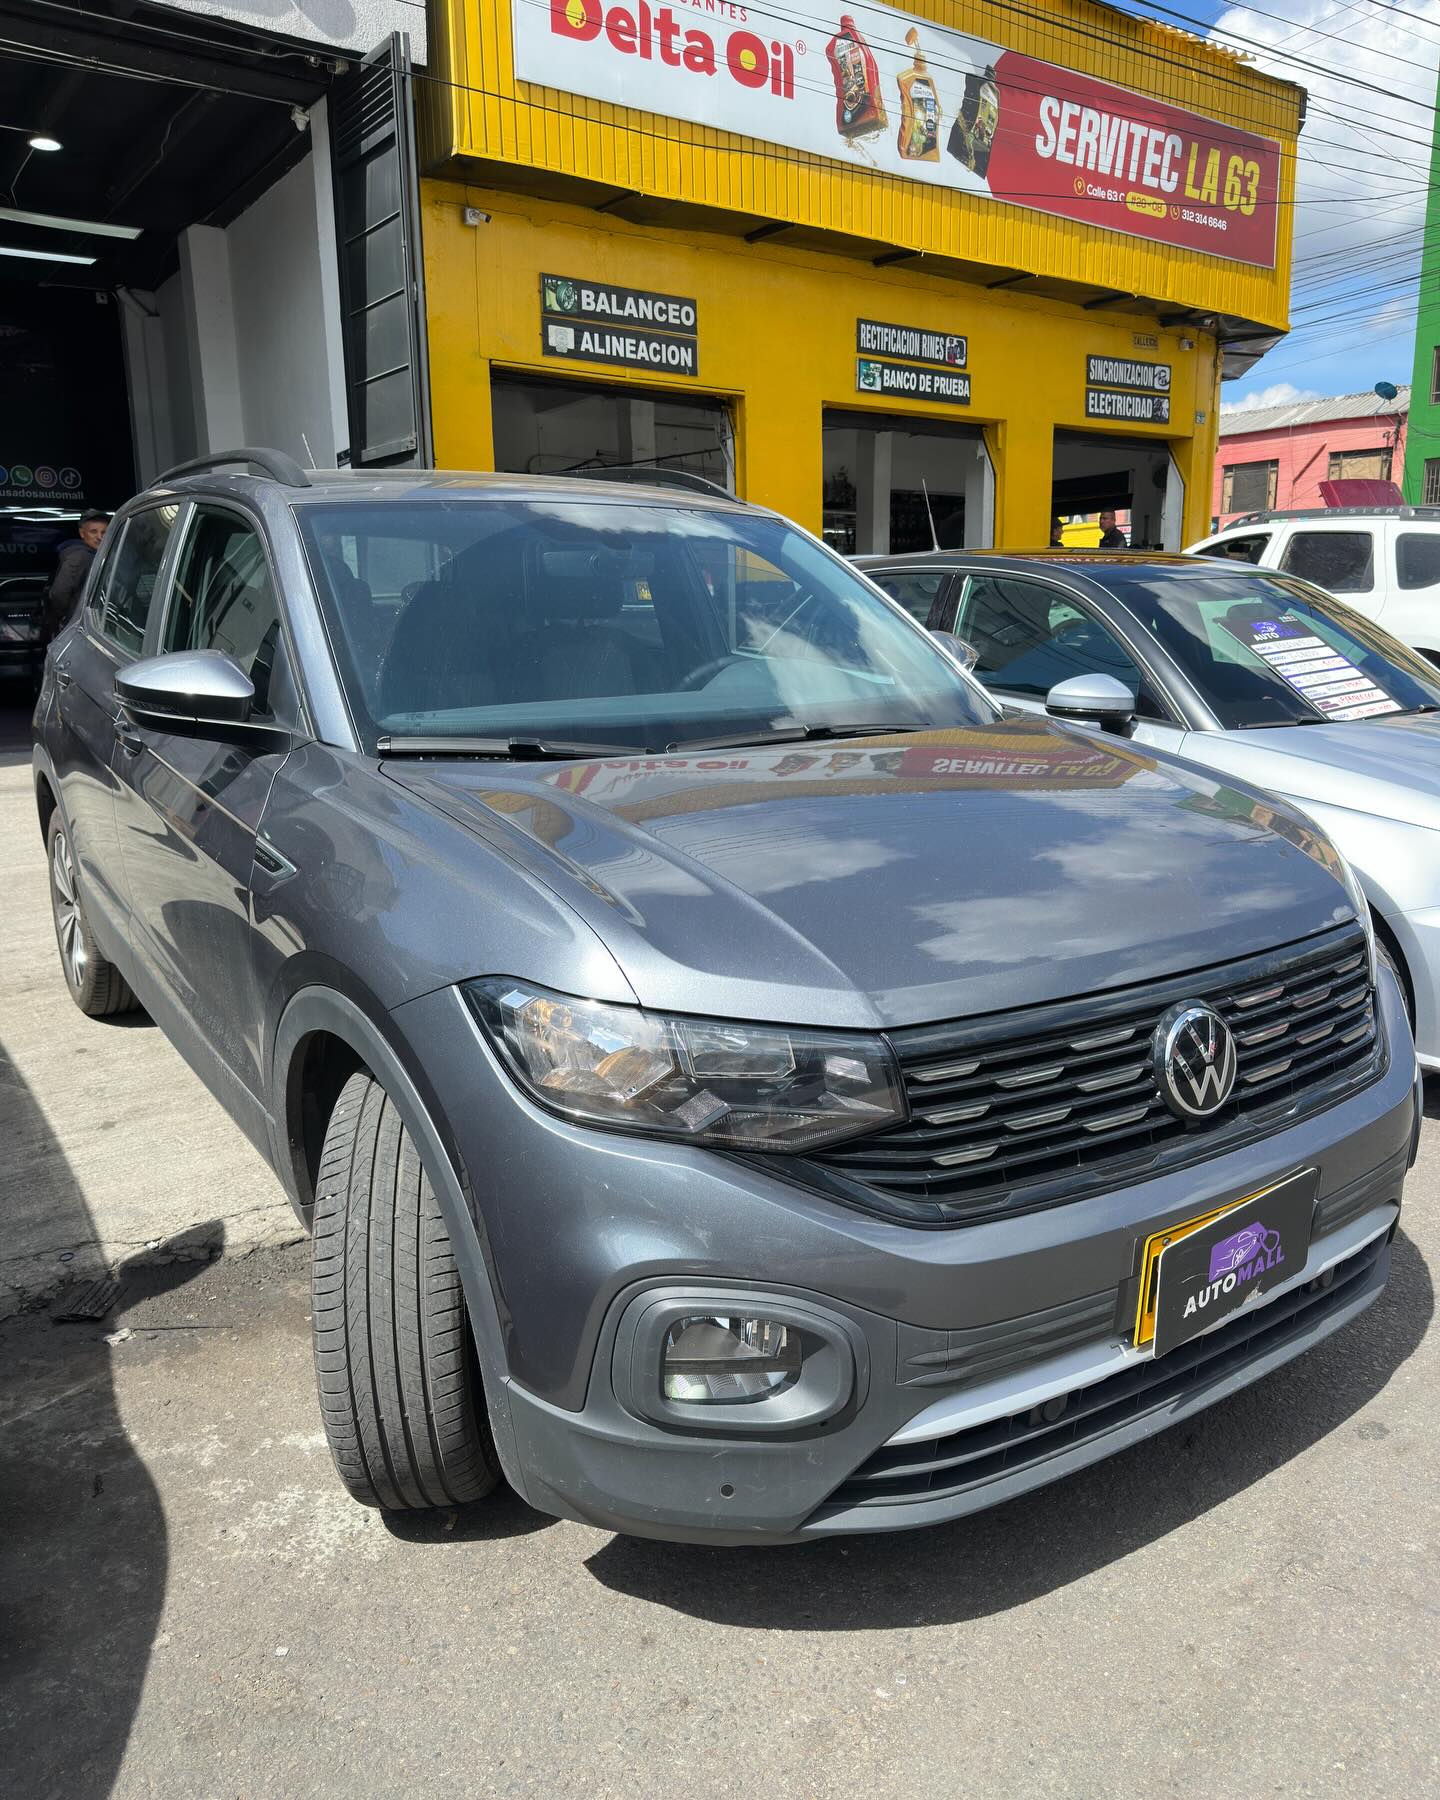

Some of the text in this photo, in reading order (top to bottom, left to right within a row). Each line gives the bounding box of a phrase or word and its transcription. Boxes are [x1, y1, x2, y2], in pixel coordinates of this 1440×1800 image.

[680, 0, 747, 22] ANTES
[551, 0, 718, 77] Delta
[1035, 95, 1260, 216] SERVITEC LA 63
[1087, 184, 1106, 199] Calle
[1107, 189, 1118, 201] 63
[1181, 209, 1194, 222] 312
[1195, 211, 1208, 226] 314
[581, 289, 695, 327] BALANCEO
[580, 331, 693, 368] ALINEACION
[860, 323, 944, 361] RECTIFICACION RINES
[883, 369, 970, 397] BANCO DE PRUEBA
[1089, 358, 1154, 387] SINCRONIZACION
[1088, 392, 1153, 419] ELECTRICIDAD
[1183, 1246, 1285, 1319] AUTOMALL
